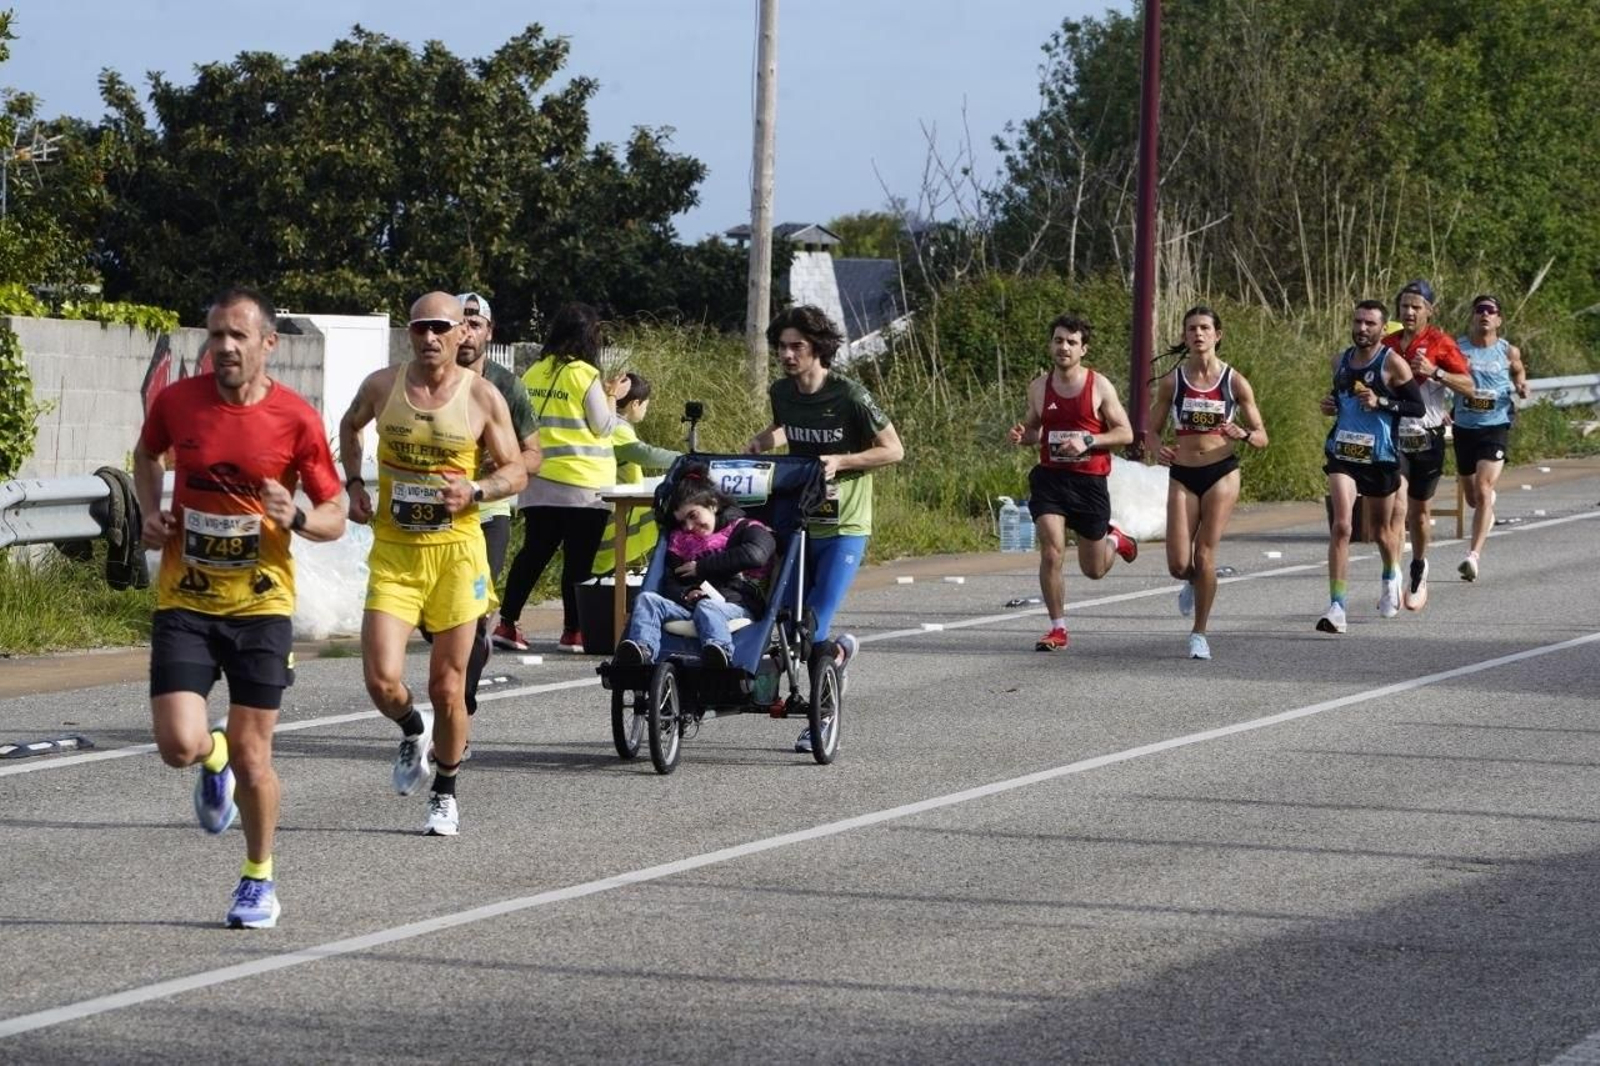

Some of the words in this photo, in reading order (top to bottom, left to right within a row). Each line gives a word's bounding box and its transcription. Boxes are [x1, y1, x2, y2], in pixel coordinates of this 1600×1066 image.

[1192, 412, 1215, 424] 863
[783, 425, 843, 443] ARINES
[1344, 444, 1365, 456] 682
[720, 475, 753, 495] C21
[411, 503, 435, 520] 33
[203, 536, 243, 556] 748
